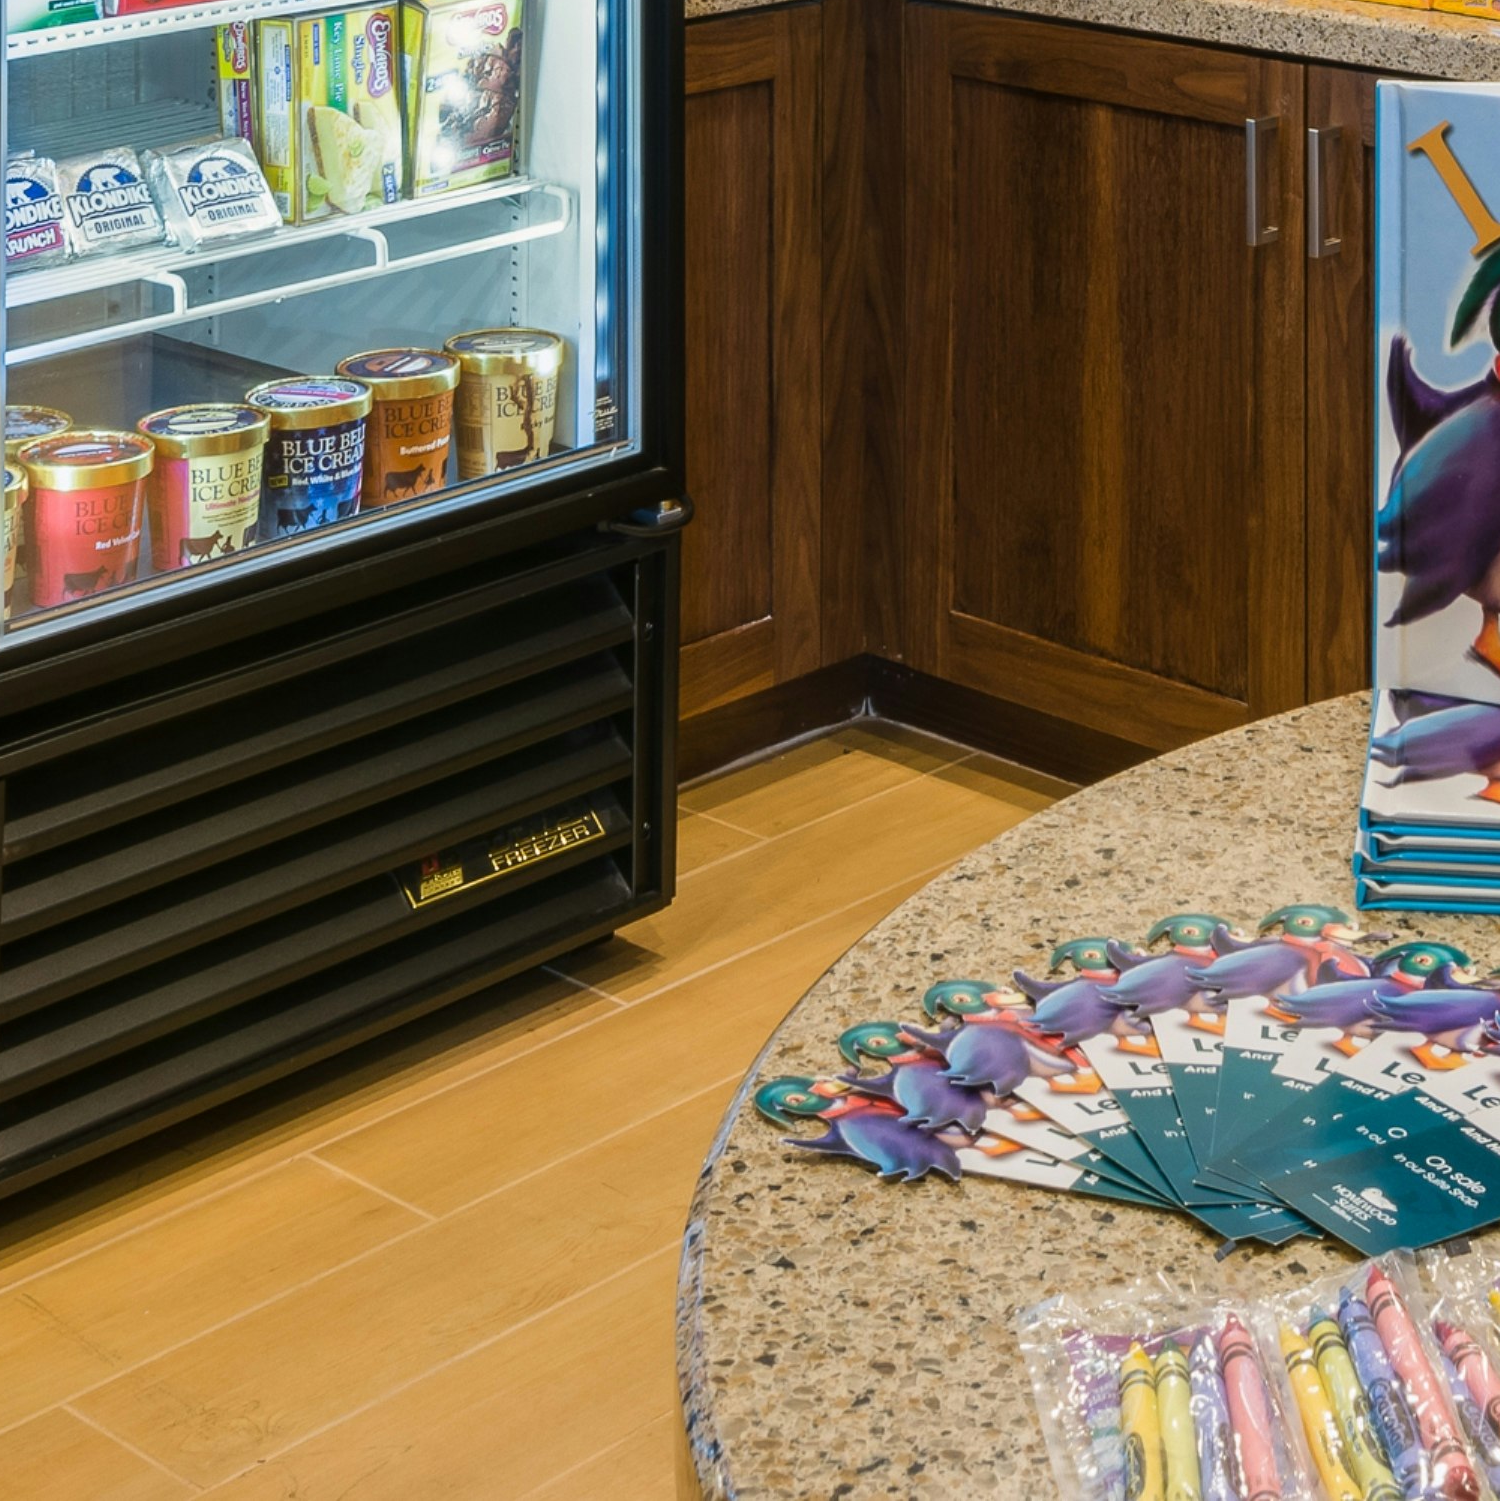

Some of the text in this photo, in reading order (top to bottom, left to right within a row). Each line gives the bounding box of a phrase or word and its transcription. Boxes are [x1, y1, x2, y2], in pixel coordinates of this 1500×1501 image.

[69, 183, 150, 225] KLONDIKE
[181, 174, 264, 215] KLONDIKE
[208, 202, 258, 220] ORIGINAL
[94, 215, 146, 234] ORIGINAL
[283, 436, 336, 457] BLUE
[192, 463, 244, 485] BLUE
[192, 485, 222, 502] ICE
[491, 824, 591, 872] FREEZER
[1459, 1125, 1488, 1145] And
[1392, 1152, 1405, 1164] in
[1403, 1158, 1424, 1175] our
[1421, 1170, 1451, 1190] Suite
[1425, 1155, 1486, 1196] On sale
